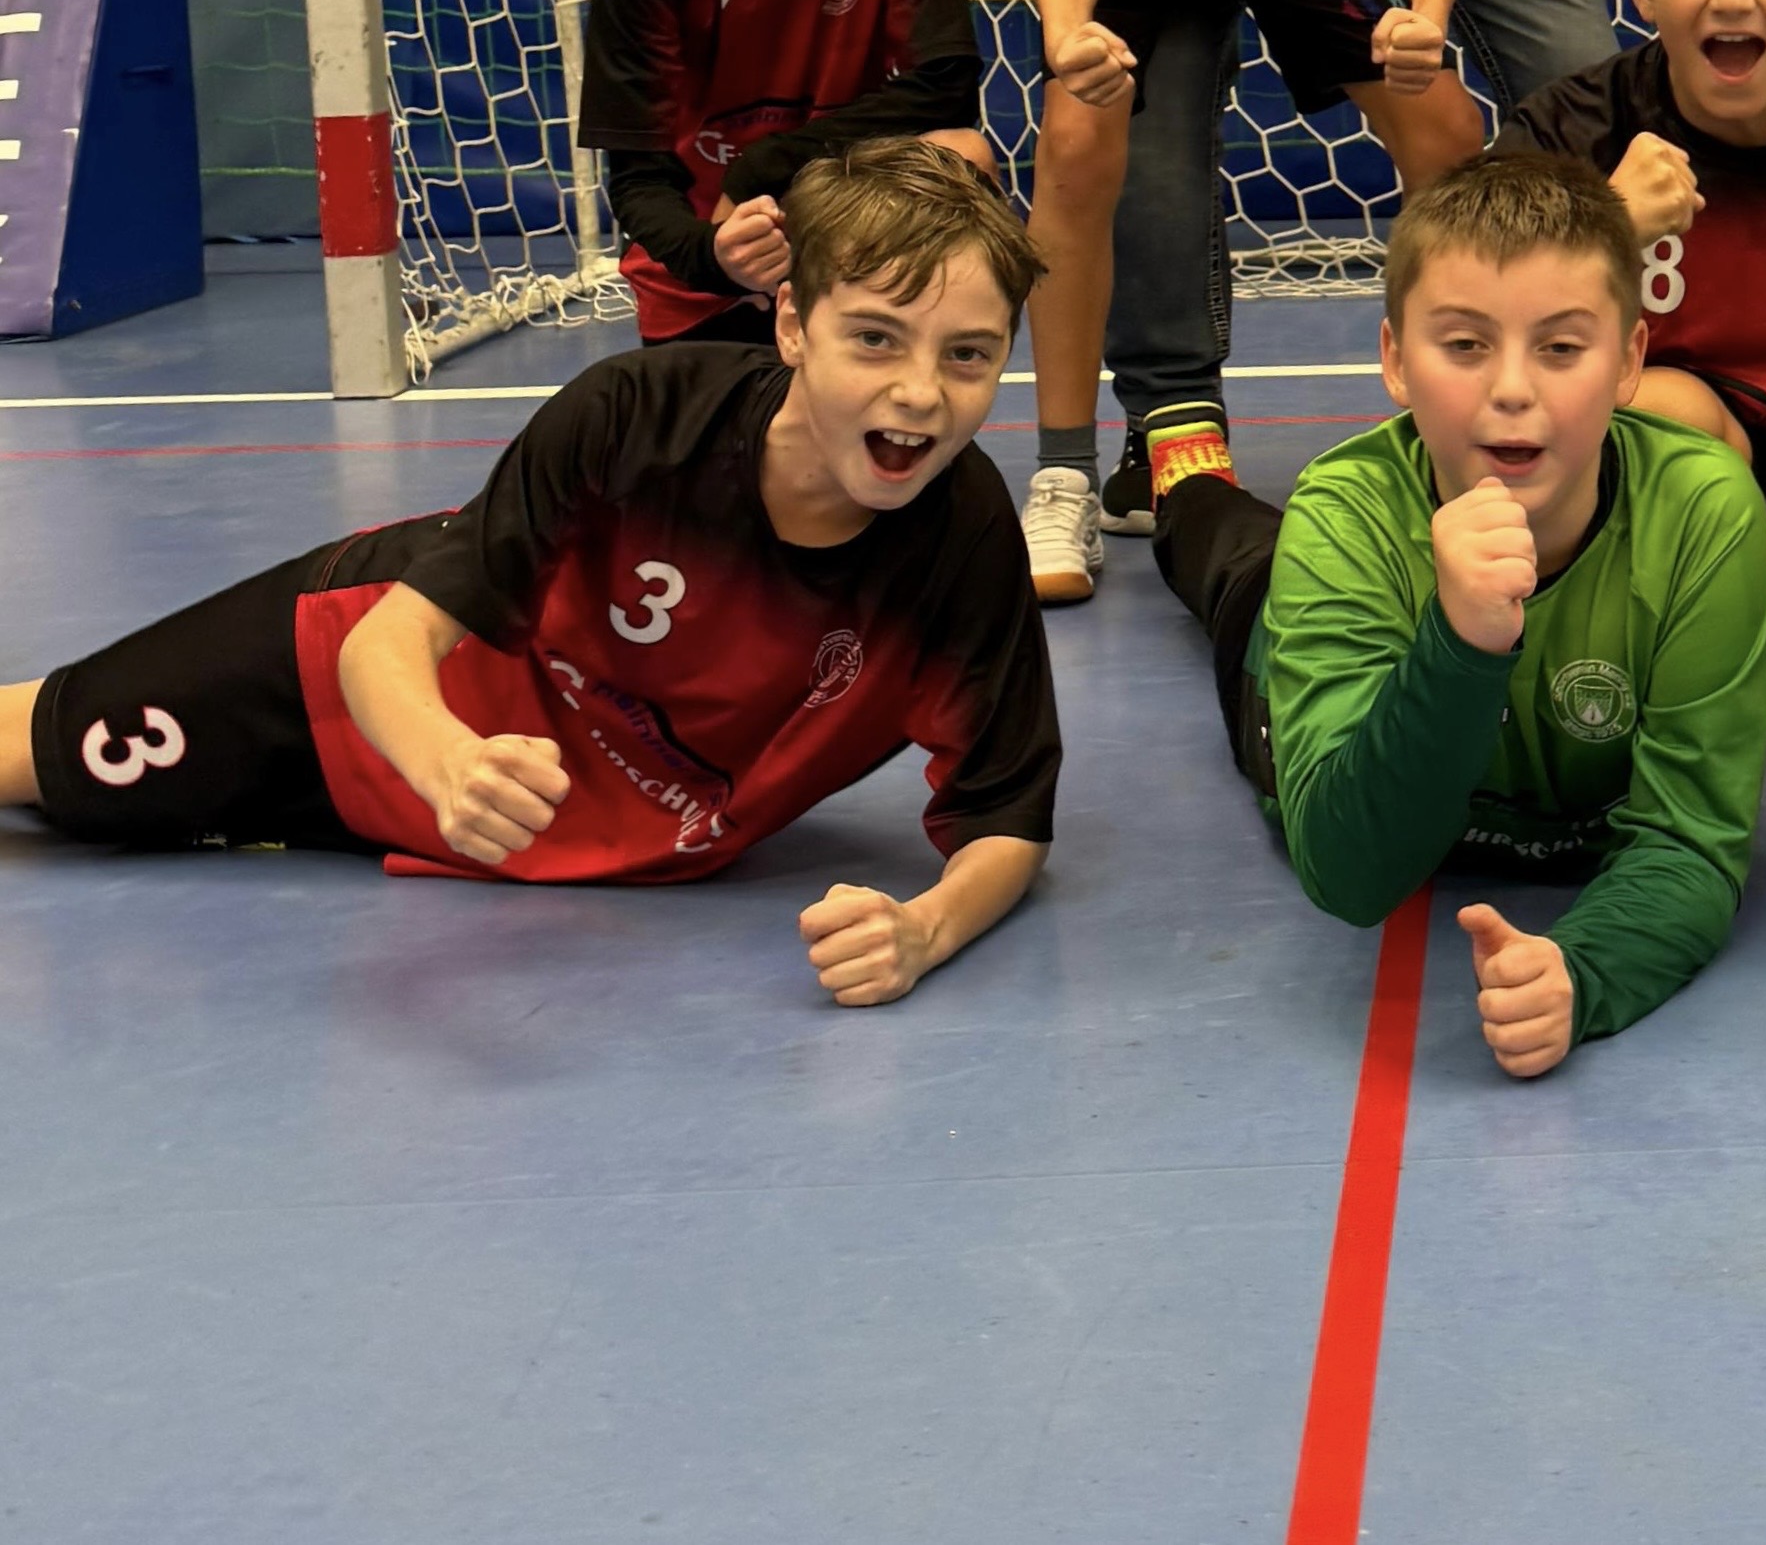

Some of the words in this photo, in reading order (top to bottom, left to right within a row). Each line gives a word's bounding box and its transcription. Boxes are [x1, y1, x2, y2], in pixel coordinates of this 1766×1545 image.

[1640, 234, 1686, 314] 8
[608, 559, 687, 645] 3
[82, 705, 187, 787] 3
